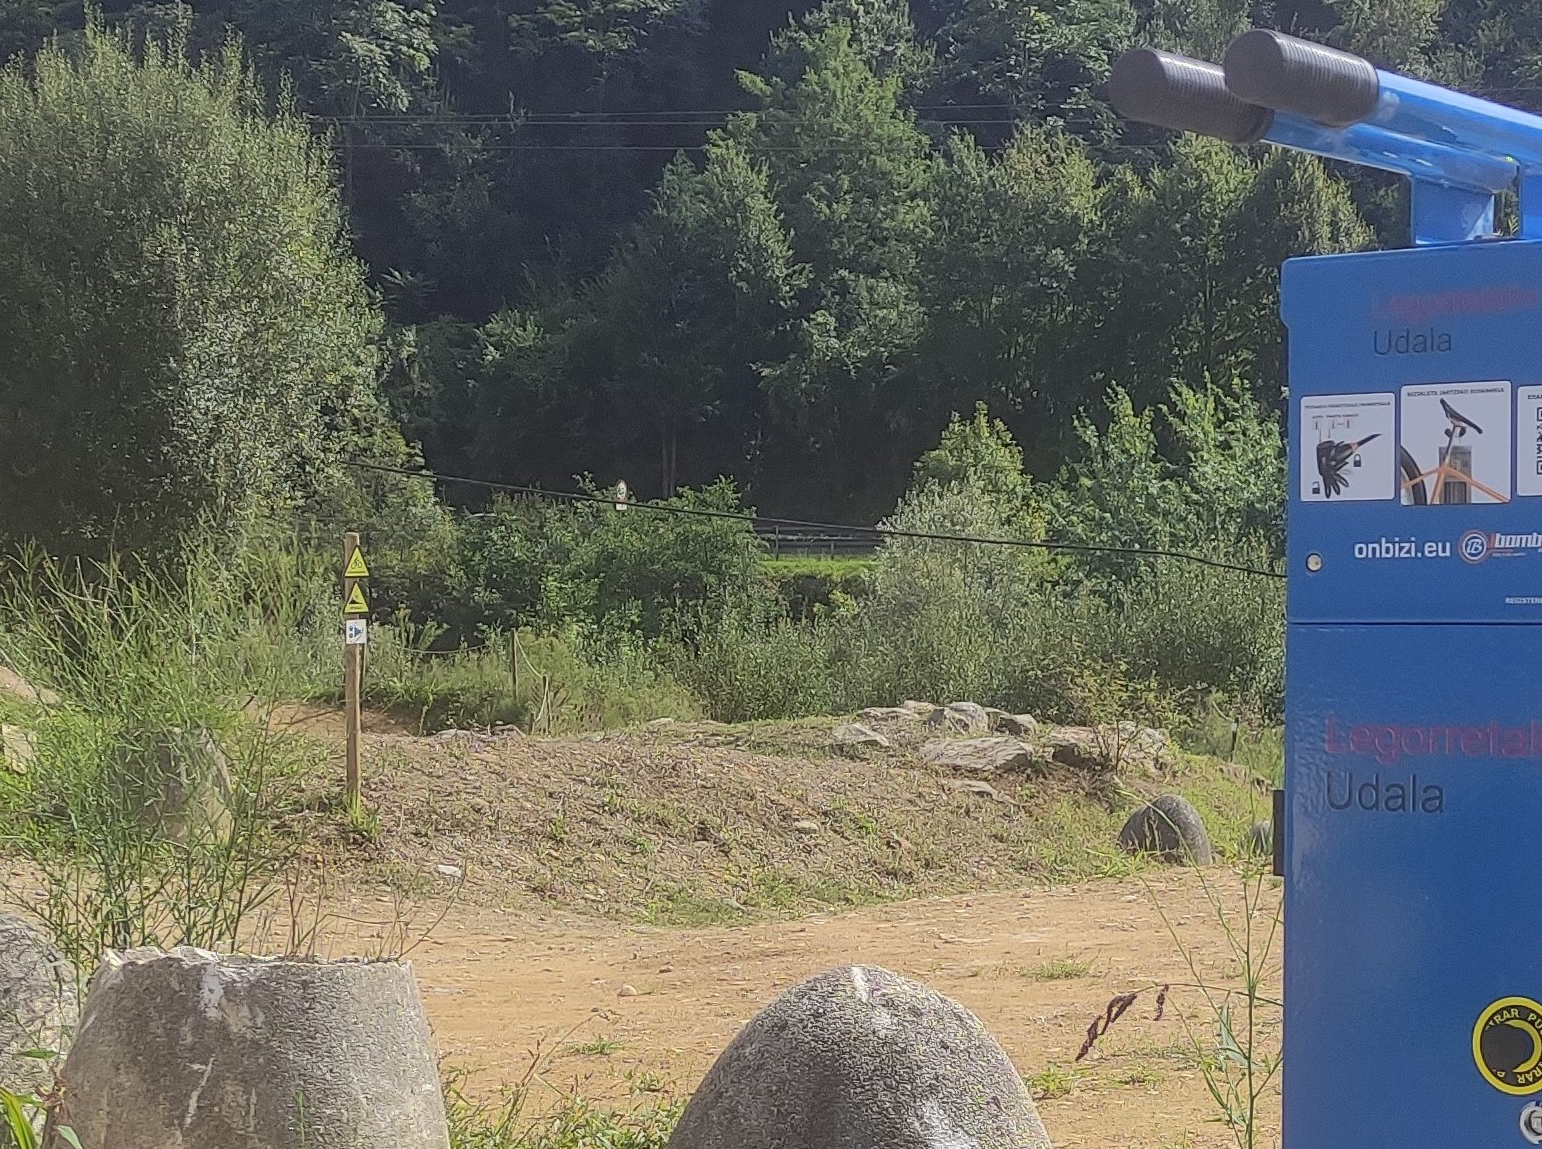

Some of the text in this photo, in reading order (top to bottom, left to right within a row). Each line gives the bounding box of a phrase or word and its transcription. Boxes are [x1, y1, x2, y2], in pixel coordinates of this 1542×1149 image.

[1373, 327, 1452, 356] Udala
[1354, 537, 1451, 559] onbizi.eu
[1325, 771, 1445, 814] Udala
